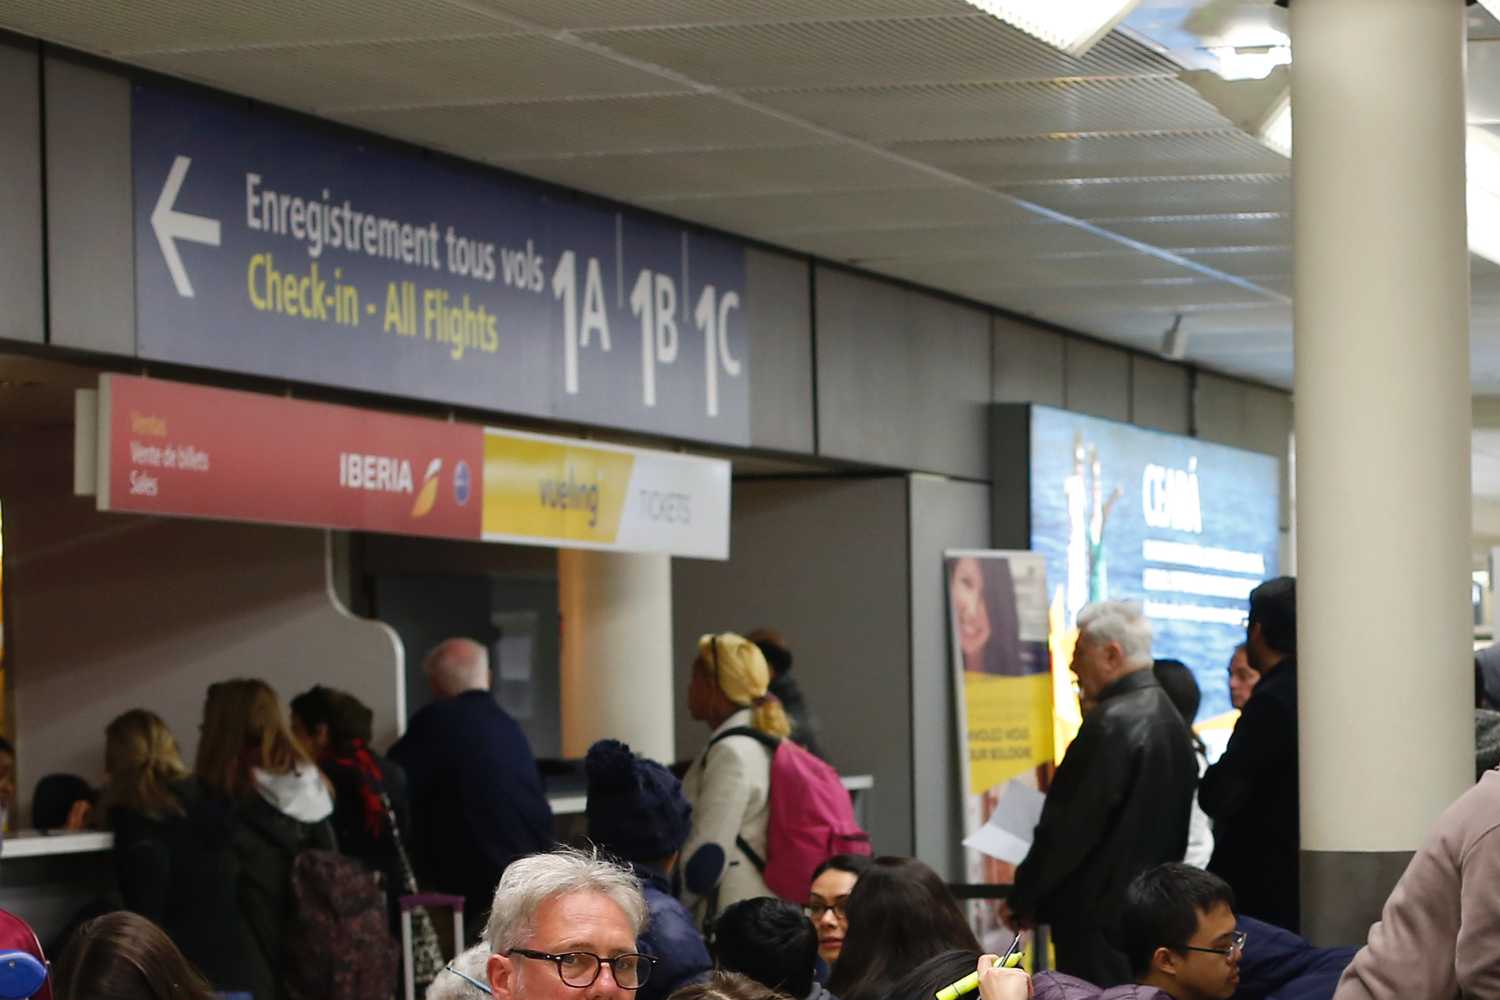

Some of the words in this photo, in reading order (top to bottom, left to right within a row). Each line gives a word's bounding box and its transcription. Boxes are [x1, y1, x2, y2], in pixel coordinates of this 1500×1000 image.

[246, 172, 440, 269] Enregistrement
[447, 225, 496, 283] tous
[500, 239, 544, 292] vols
[248, 252, 359, 326] Check-in
[384, 280, 417, 336] All
[424, 287, 498, 360] Flights
[552, 250, 611, 394] 1A
[630, 269, 678, 407] 1B
[695, 285, 740, 417] 1C
[340, 453, 413, 493] IBERIA
[539, 464, 598, 527] vueling
